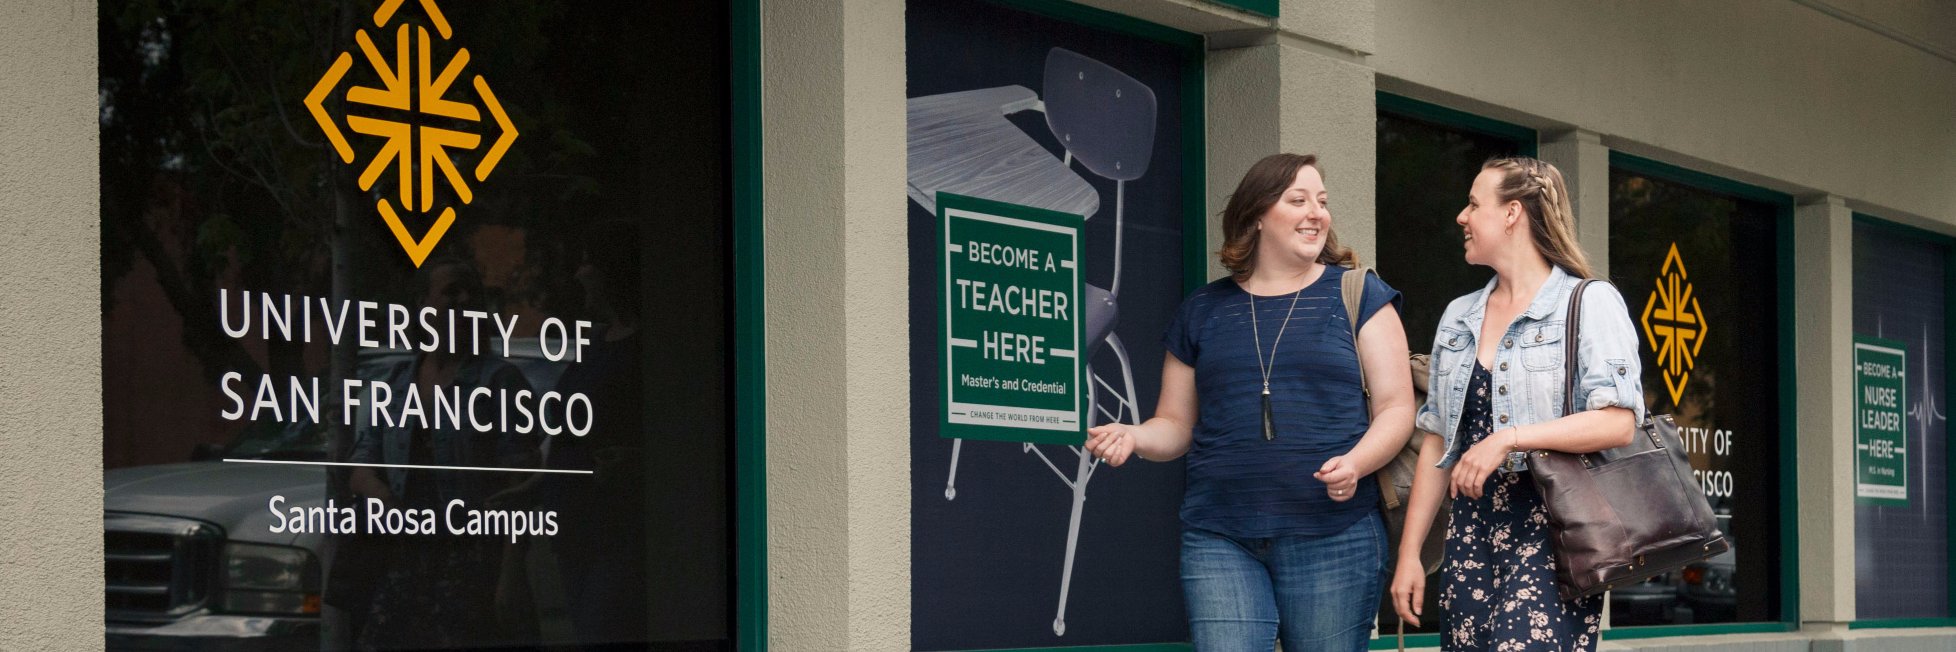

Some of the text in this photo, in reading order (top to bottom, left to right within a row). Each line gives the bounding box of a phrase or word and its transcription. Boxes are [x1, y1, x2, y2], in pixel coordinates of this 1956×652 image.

[968, 240, 1056, 273] BECOME A
[956, 278, 1068, 321] TEACHER
[220, 288, 592, 363] UNIVERSITY OF
[983, 330, 1046, 365] HERE
[1863, 361, 1897, 379] BECOME A
[961, 373, 1066, 395] Master's and Credential
[1864, 385, 1897, 408] NURSE
[220, 371, 593, 437] SAN FRANCISCO
[970, 410, 1060, 424] CHANGE THE WORLD FROM HERE
[1862, 409, 1900, 432] LEADER
[1714, 429, 1733, 456] OF
[1869, 438, 1894, 459] HERE
[1693, 469, 1733, 497] ISCO
[268, 495, 559, 544] Santa Rosa Campus
